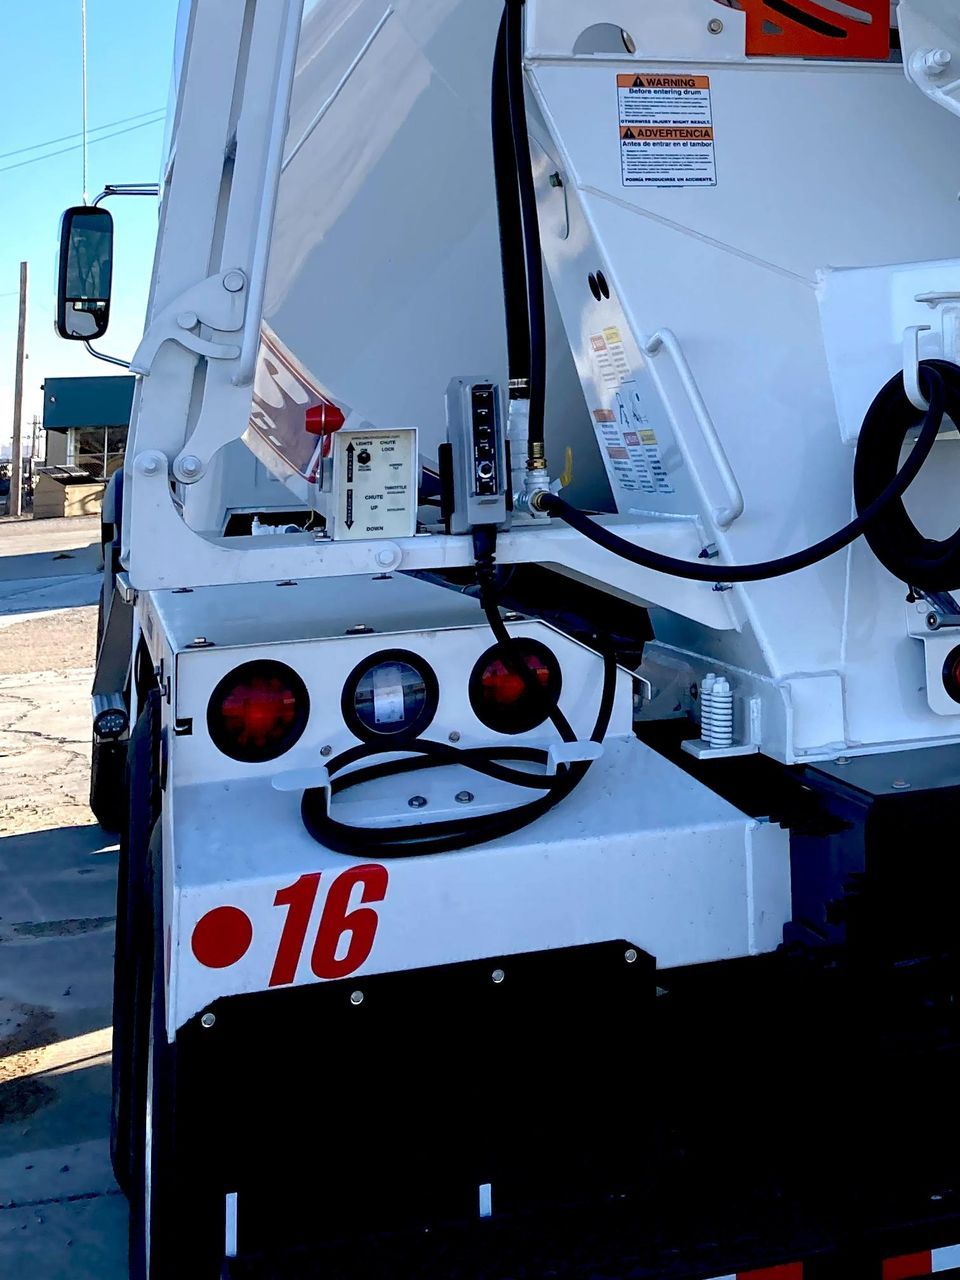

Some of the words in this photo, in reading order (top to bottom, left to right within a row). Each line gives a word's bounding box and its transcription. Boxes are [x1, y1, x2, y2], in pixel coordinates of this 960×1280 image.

[646, 78, 695, 87] WARNING
[638, 129, 710, 138] ADVERTENCIA
[269, 864, 388, 987] 16
